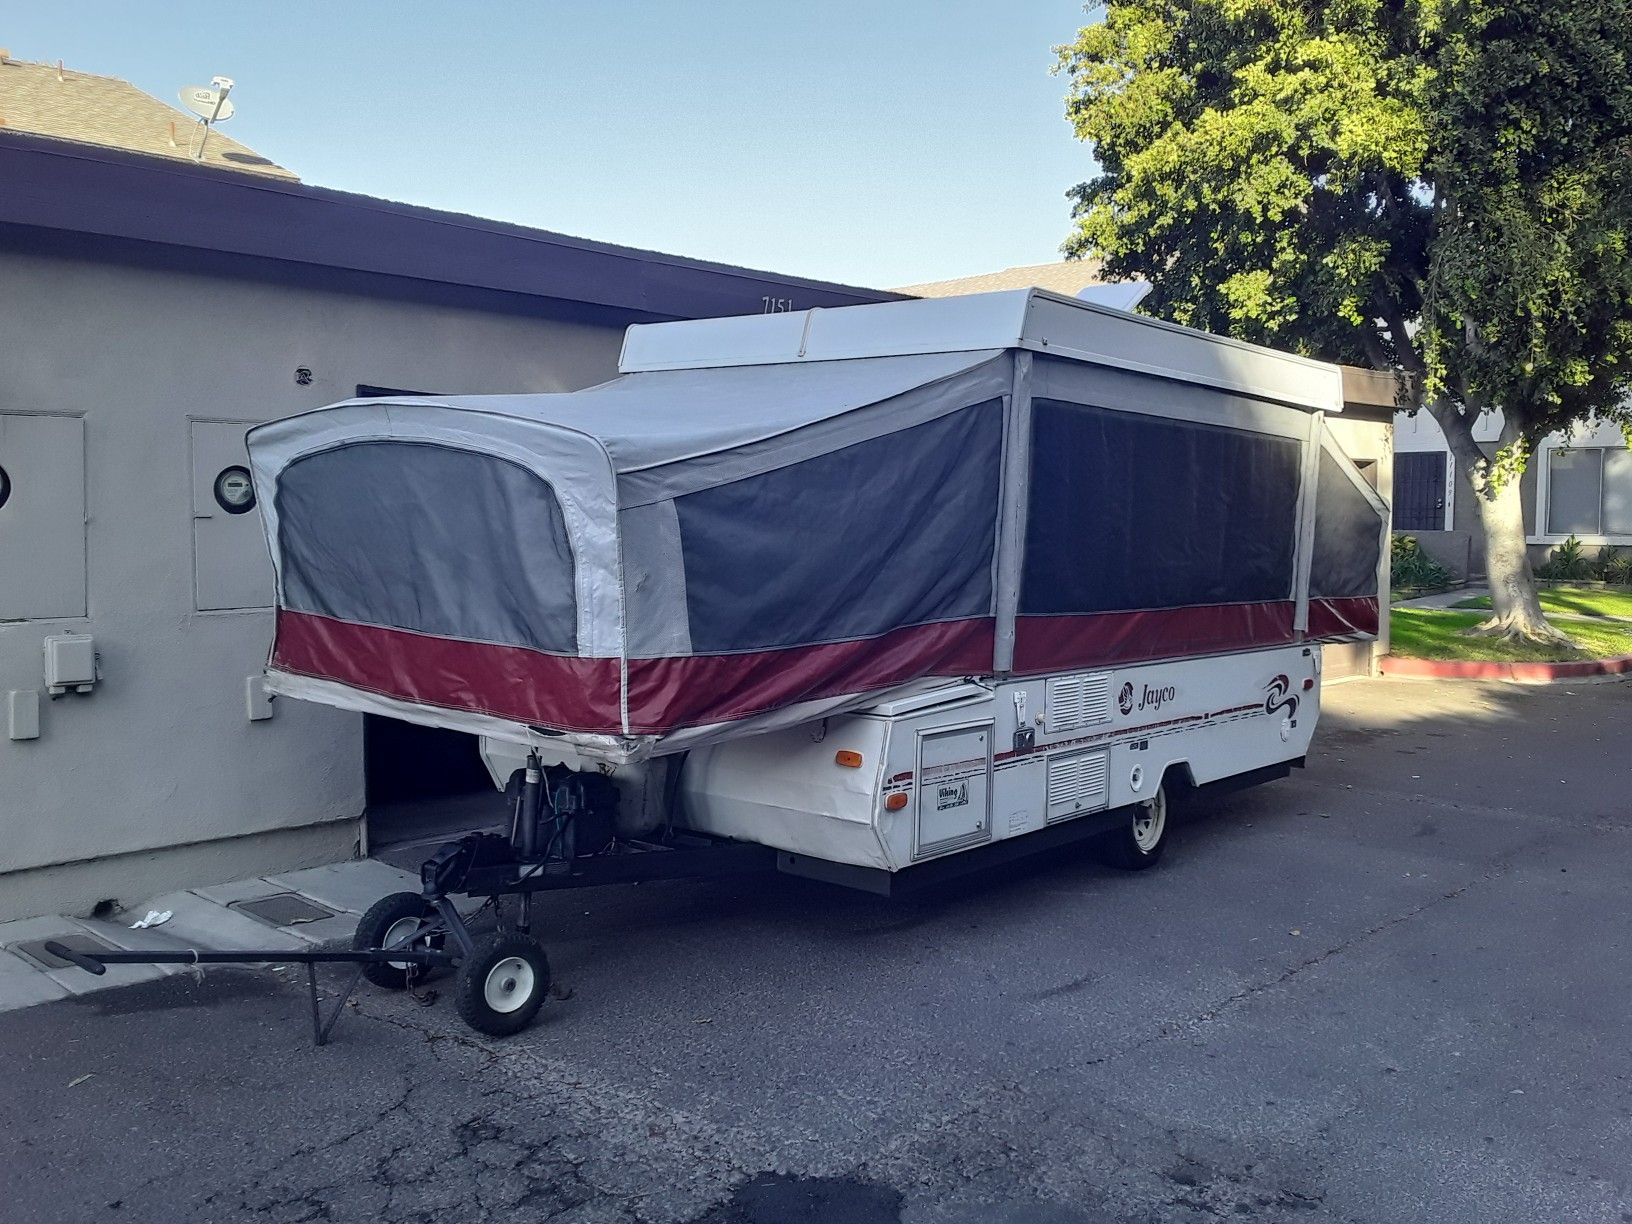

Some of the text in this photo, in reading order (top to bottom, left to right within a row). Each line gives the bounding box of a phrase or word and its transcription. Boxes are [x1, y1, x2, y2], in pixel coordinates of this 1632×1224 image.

[762, 296, 793, 314] 7151
[1138, 684, 1175, 711] Jayco
[939, 786, 958, 800] Viking
